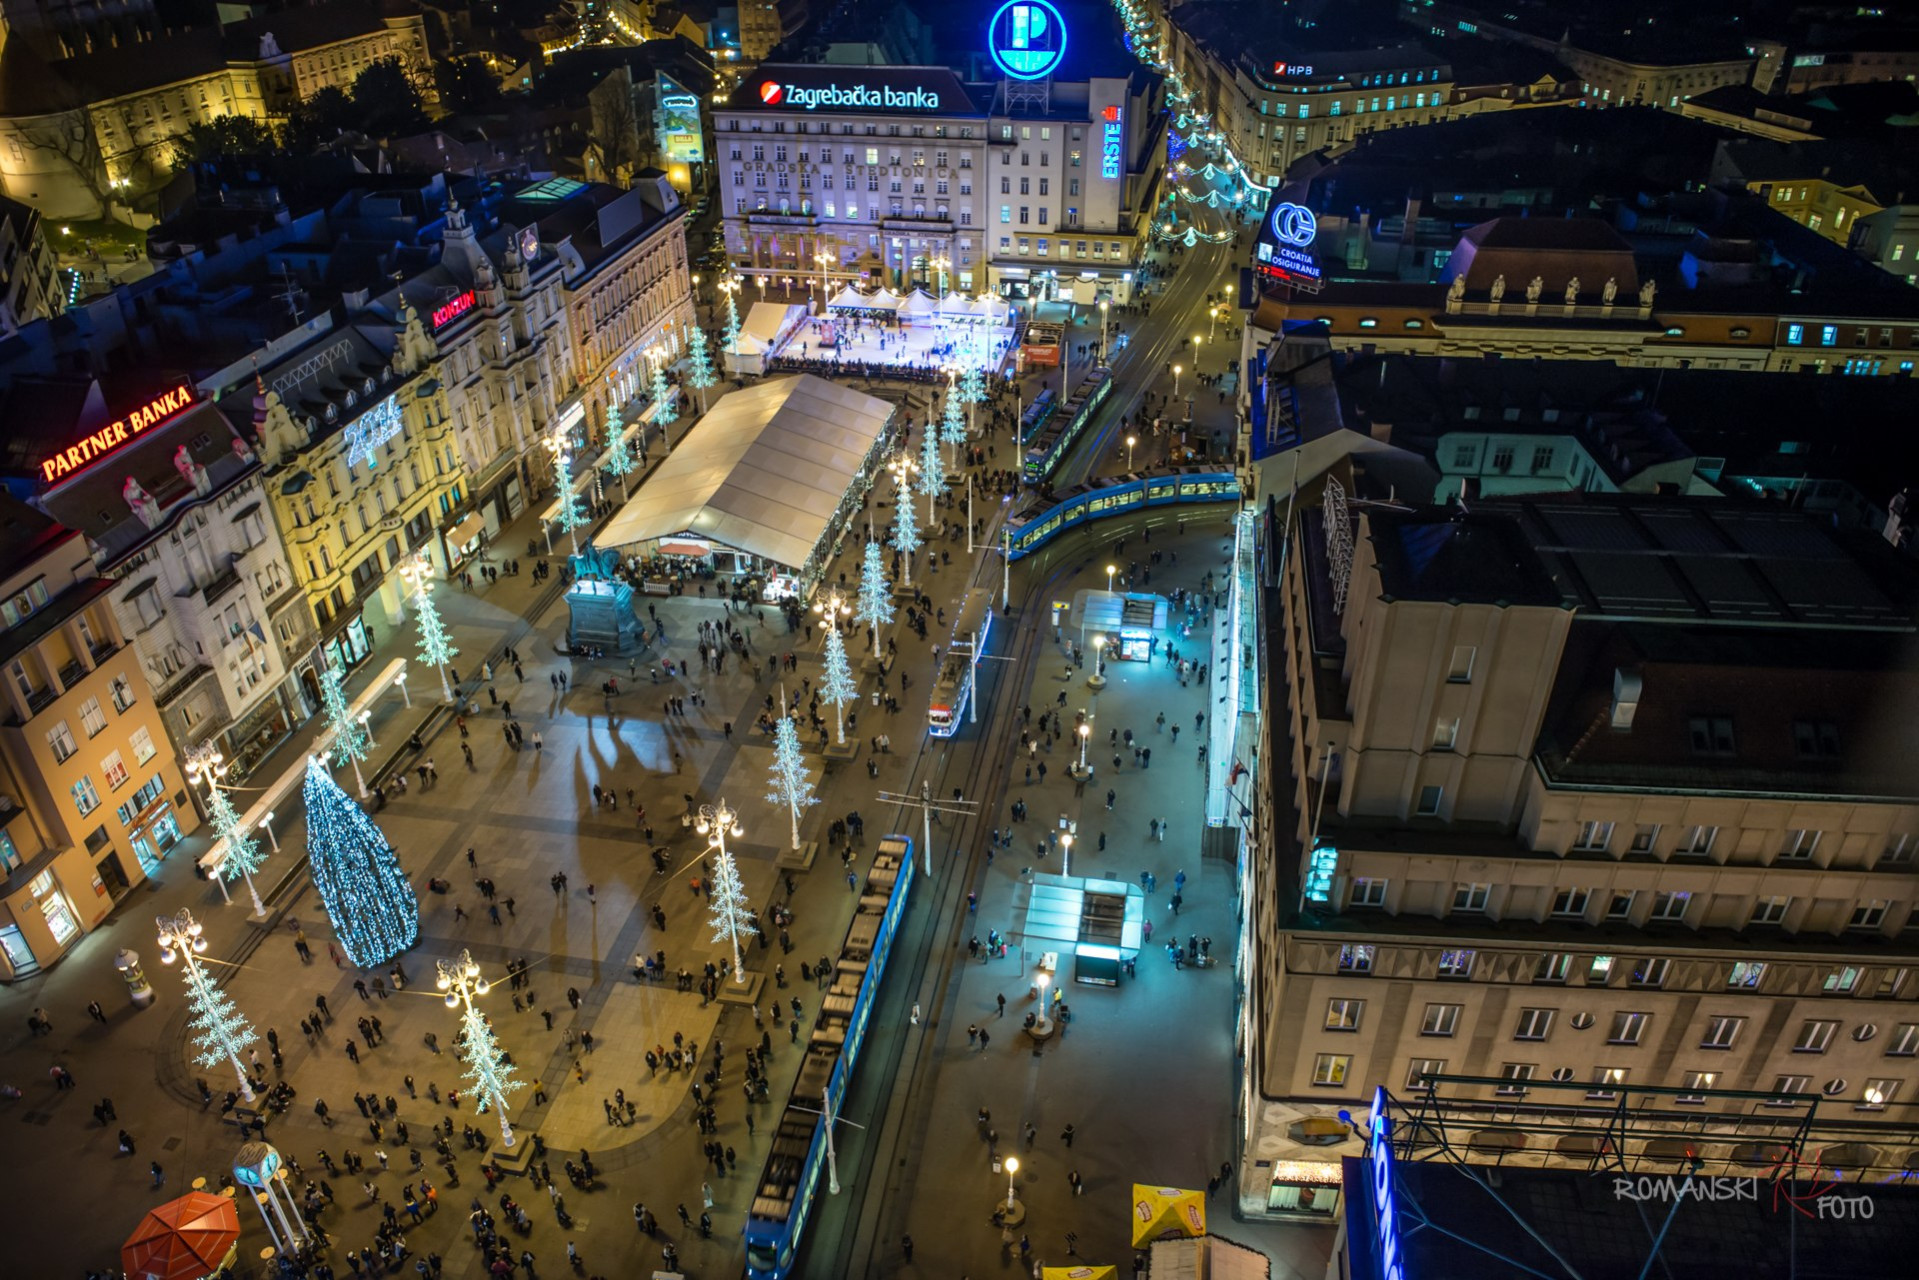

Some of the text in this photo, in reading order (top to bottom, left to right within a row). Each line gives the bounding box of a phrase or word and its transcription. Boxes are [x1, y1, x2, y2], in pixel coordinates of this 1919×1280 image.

[1287, 65, 1312, 75] HPB
[784, 84, 939, 109] Zagrebačka banka
[1102, 123, 1121, 179] ERSTE
[743, 161, 820, 174] GRADSKA
[1272, 256, 1320, 277] OSIGURANJE
[1281, 248, 1312, 264] CROATIA
[42, 386, 191, 482] PARTNER BANKA
